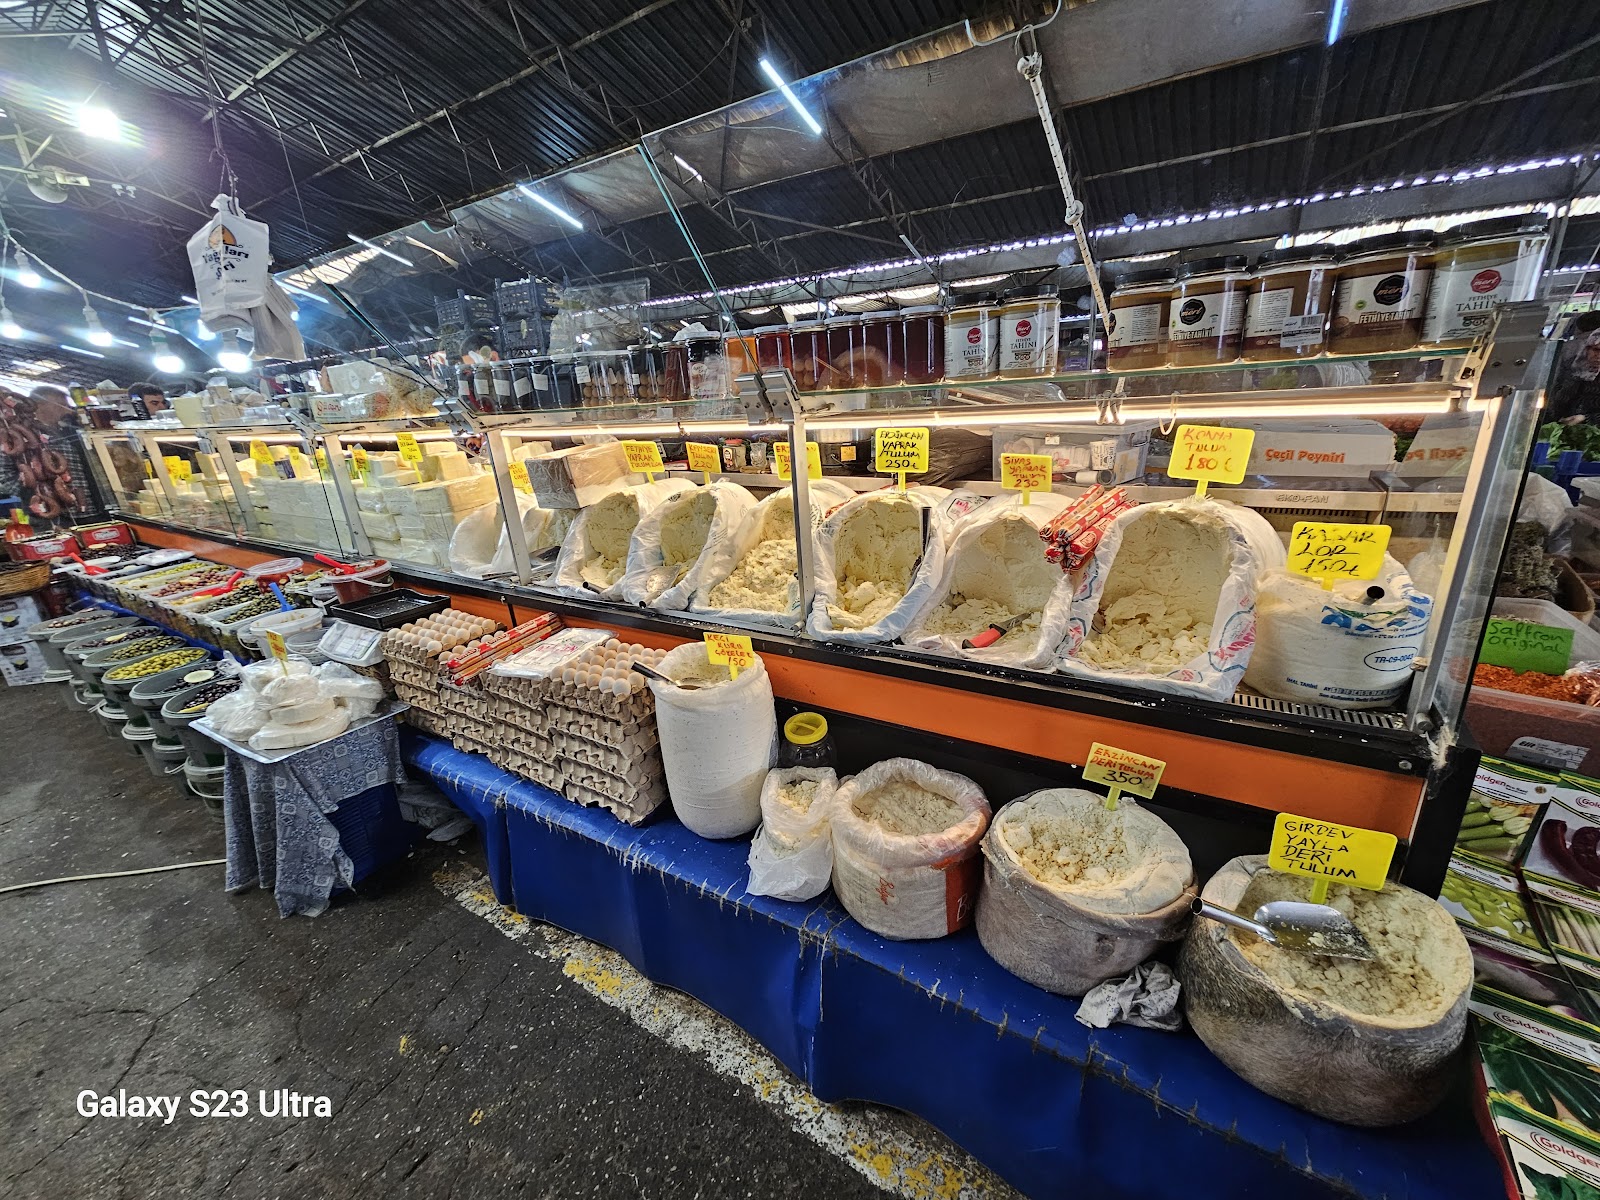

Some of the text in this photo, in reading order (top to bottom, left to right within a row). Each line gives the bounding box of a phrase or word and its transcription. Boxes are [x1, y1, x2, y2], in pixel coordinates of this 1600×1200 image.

[1489, 622, 1566, 643] Saffron
[1103, 769, 1143, 785] 350
[1475, 774, 1507, 787] oldgen
[1284, 821, 1355, 839] GİRDEV
[1286, 833, 1349, 853] YAYLA
[1280, 845, 1333, 865] DERİ
[1283, 858, 1356, 879] TULUM
[1501, 1014, 1556, 1039] Goldgen
